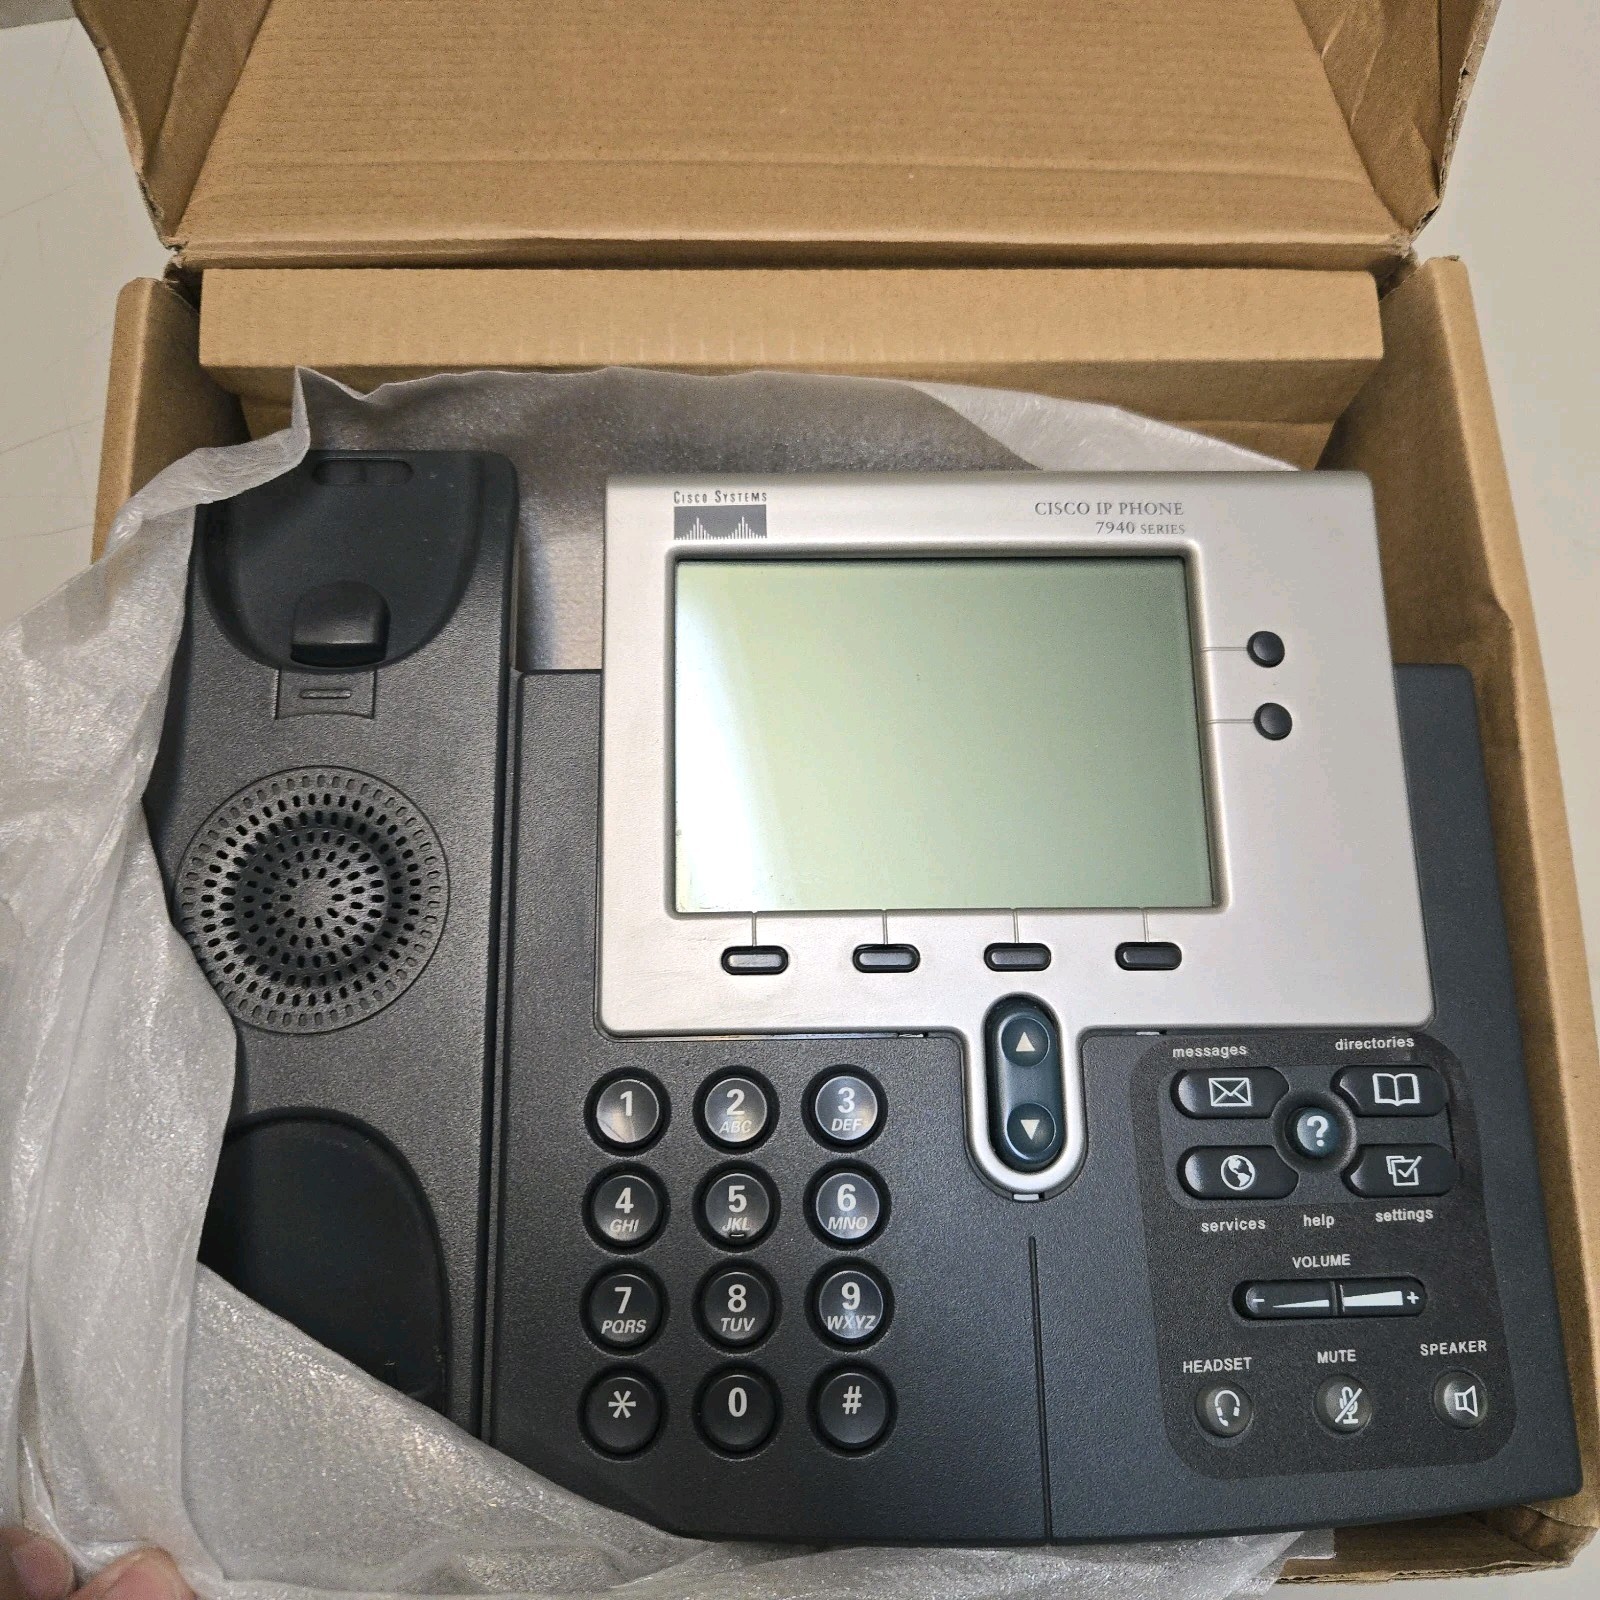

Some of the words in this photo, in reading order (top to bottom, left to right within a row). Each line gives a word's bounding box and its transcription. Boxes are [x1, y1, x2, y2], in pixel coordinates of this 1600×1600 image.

[1035, 502, 1090, 515] CISCO
[1096, 502, 1112, 515] IP
[1119, 502, 1184, 515] PHONE
[1096, 522, 1135, 534] 7940
[1141, 524, 1185, 534] SERIES
[1172, 1043, 1247, 1059] messages
[1335, 1035, 1415, 1051] directories
[620, 1090, 633, 1117] 1
[726, 1088, 745, 1116] 2
[837, 1087, 856, 1114] 3
[719, 1120, 752, 1134] ABC
[831, 1118, 863, 1131] DEF
[614, 1187, 634, 1214] 4
[728, 1185, 747, 1213] 5
[837, 1183, 857, 1212] 6
[827, 1216, 868, 1231] MNO
[1303, 1213, 1335, 1229] help
[1375, 1208, 1434, 1223] settings
[609, 1219, 639, 1233] GHI
[722, 1217, 751, 1232] JKL
[1201, 1217, 1266, 1233] services
[1292, 1253, 1351, 1269] VOLUME
[614, 1286, 633, 1314] 7
[727, 1284, 747, 1312] 8
[841, 1282, 861, 1311] 9
[601, 1319, 647, 1334] PQRS
[720, 1317, 755, 1332] TUV
[826, 1315, 876, 1332] WXYZ
[1419, 1340, 1488, 1355] SPEAKER
[1317, 1349, 1357, 1364] MUTE
[1182, 1356, 1252, 1374] HEADSET
[728, 1387, 748, 1417] 0
